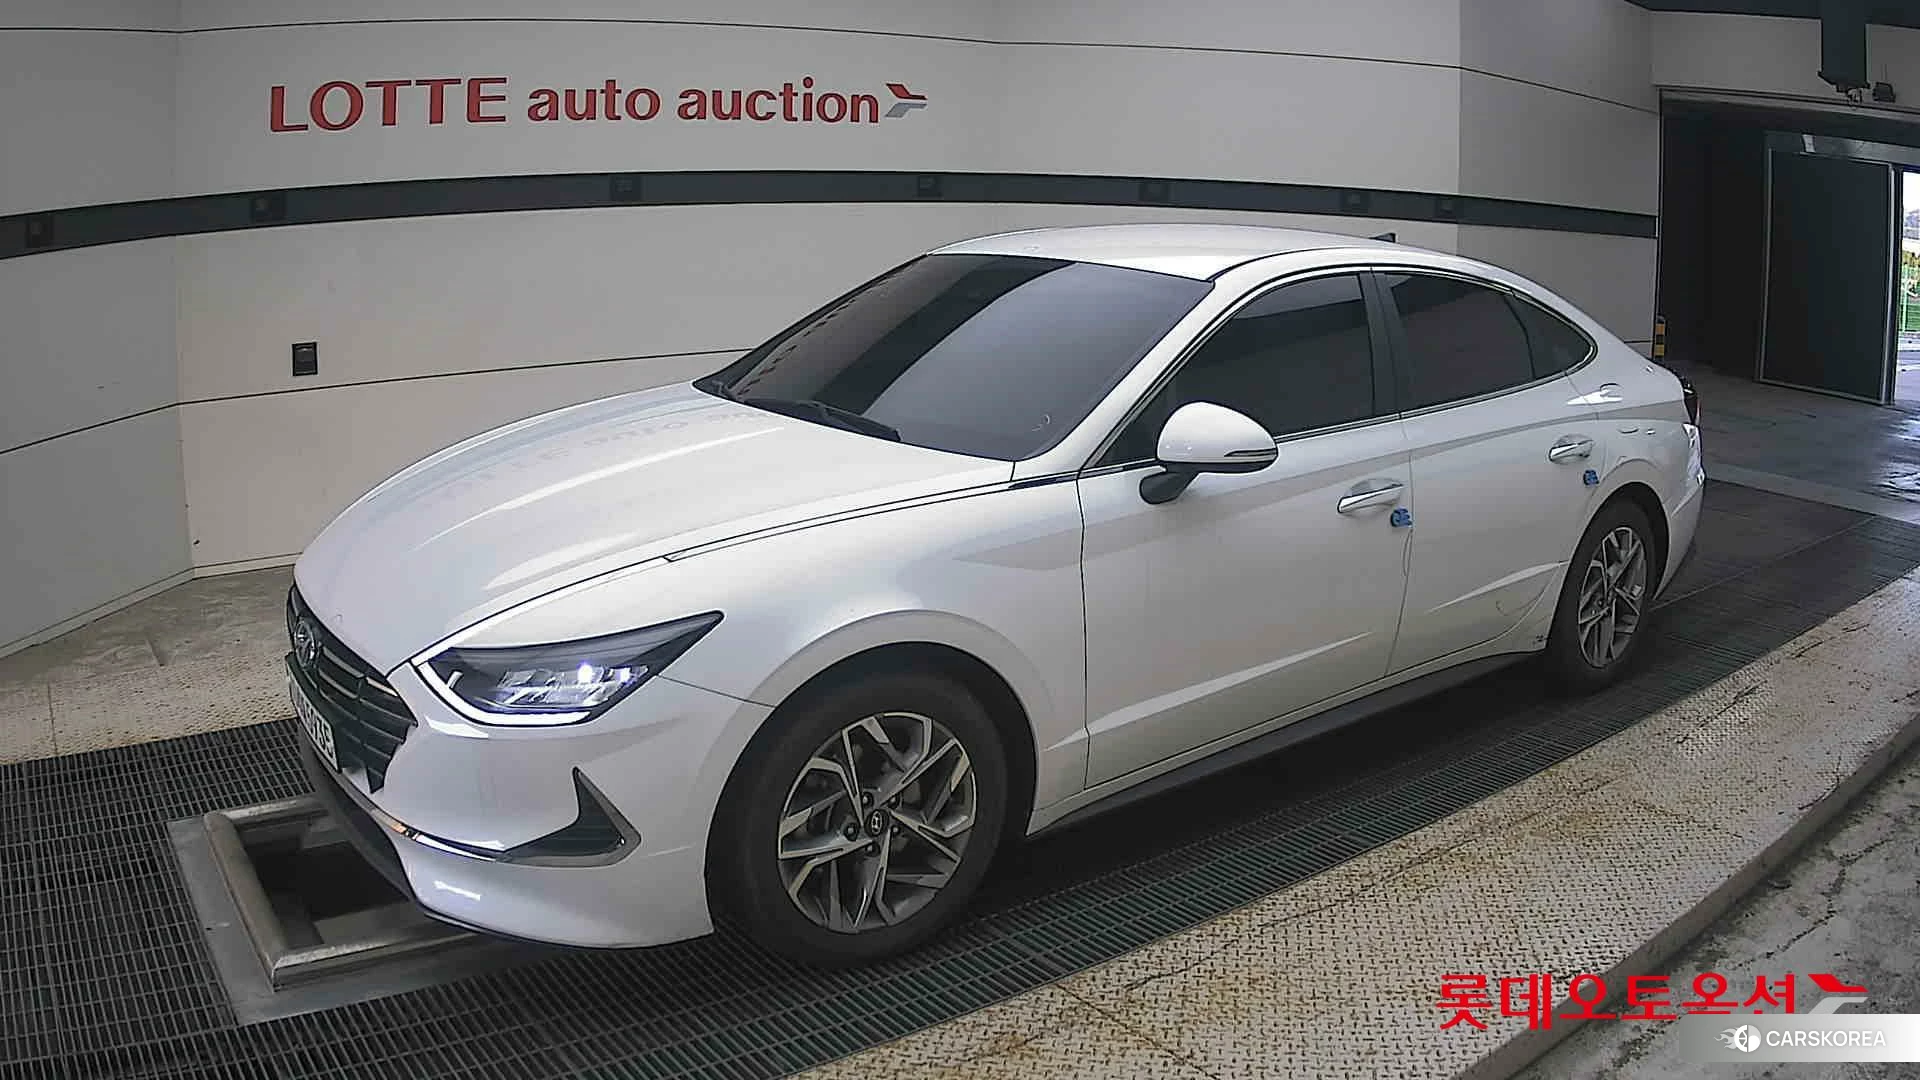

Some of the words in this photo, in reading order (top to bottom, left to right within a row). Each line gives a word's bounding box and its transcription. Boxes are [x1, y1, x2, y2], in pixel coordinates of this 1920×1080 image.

[271, 77, 508, 132] LOTTE
[527, 79, 660, 122] auto
[677, 78, 880, 124] auction
